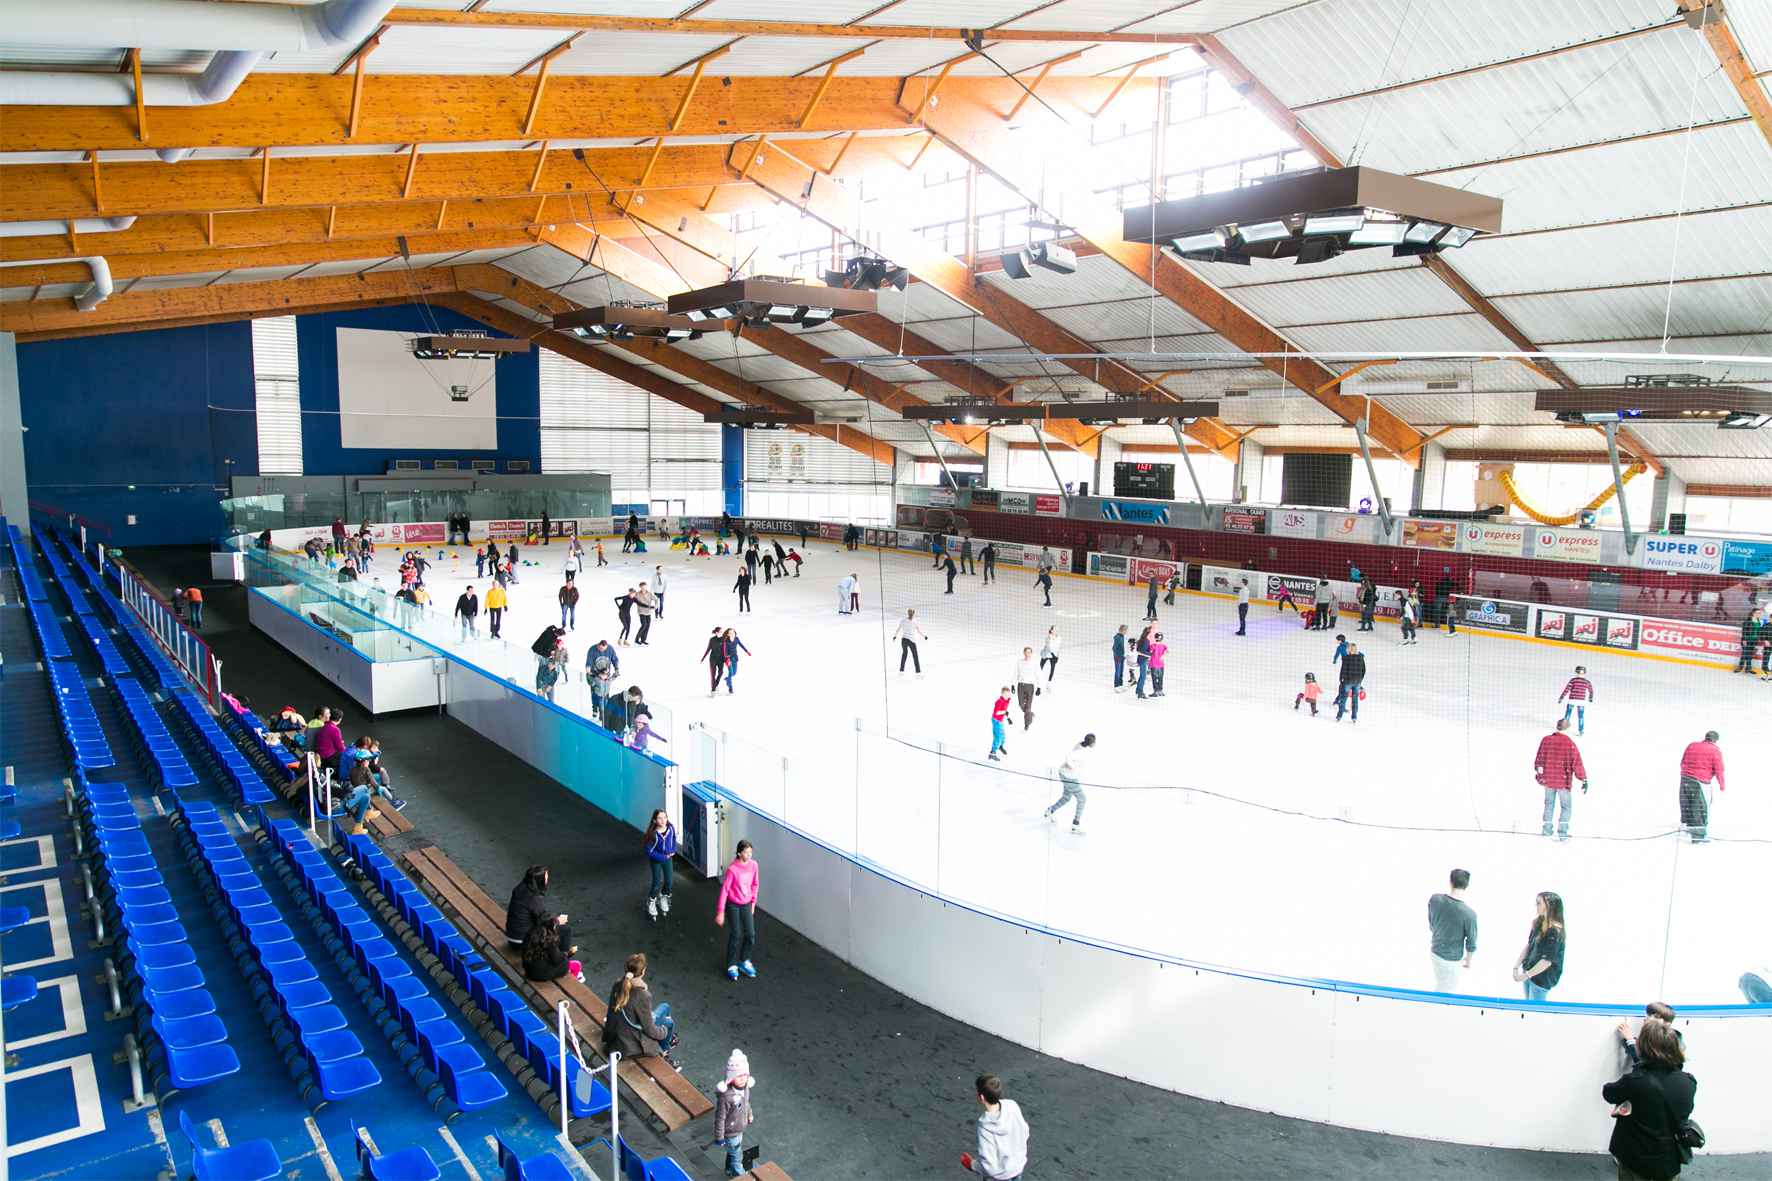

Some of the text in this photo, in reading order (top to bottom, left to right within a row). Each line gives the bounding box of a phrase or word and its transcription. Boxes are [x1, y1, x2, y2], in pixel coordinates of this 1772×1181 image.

[1484, 531, 1521, 541] express
[1559, 537, 1599, 547] express
[1647, 541, 1698, 555] SUPER
[1647, 558, 1717, 571] Nantes Dalby
[1284, 580, 1316, 592] NANTES
[1642, 629, 1705, 647] Office
